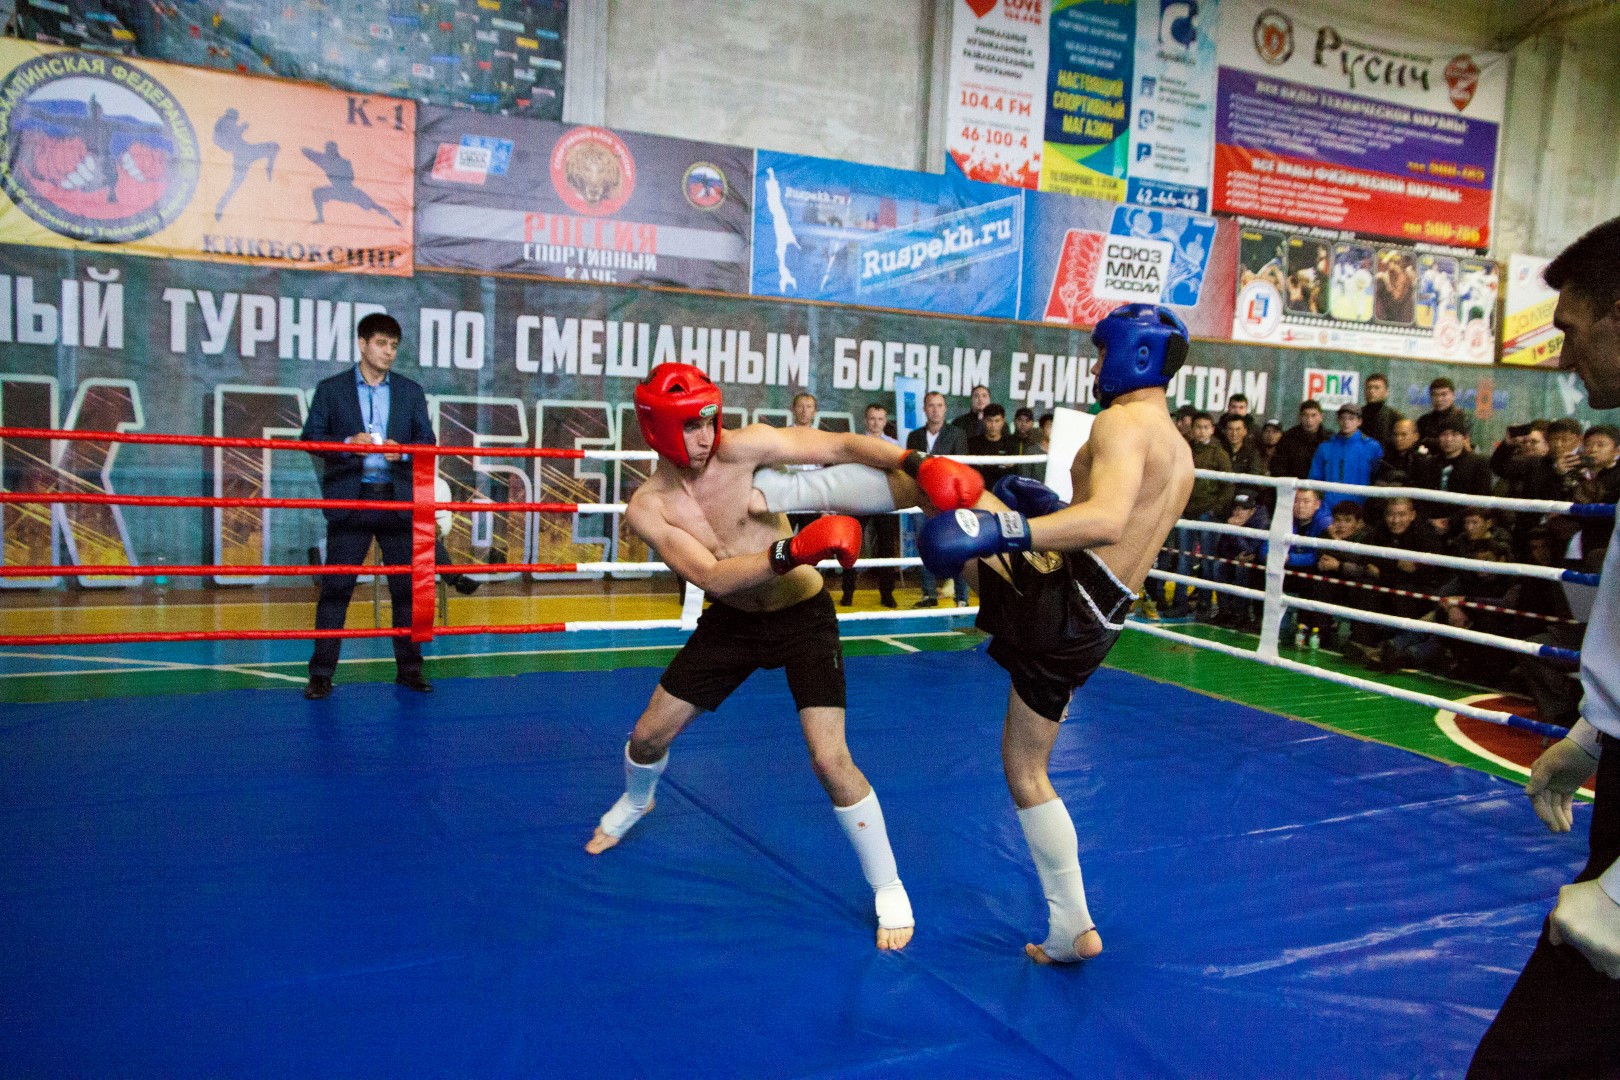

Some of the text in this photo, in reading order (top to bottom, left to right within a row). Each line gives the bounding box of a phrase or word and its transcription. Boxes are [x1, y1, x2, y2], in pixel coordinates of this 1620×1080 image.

[111, 65, 195, 157] ФЕДЕРАЦИЯ
[960, 90, 1031, 117] 104.4 FM
[523, 212, 657, 254] РОССИЯ
[861, 216, 1012, 279] Ruspekh.ru
[202, 233, 402, 268] КИКБОКСИНГ
[523, 242, 656, 272] СПОРТИВНЫЙ
[1107, 244, 1162, 264] СОЮЗ
[1105, 278, 1160, 294] РОССИИ
[1106, 261, 1160, 281] ММА
[0, 267, 124, 349] ЫЙ
[419, 307, 485, 370] ПО
[516, 314, 810, 388] СМЕШАННЫМ
[833, 337, 991, 397] БОЕВЫМ
